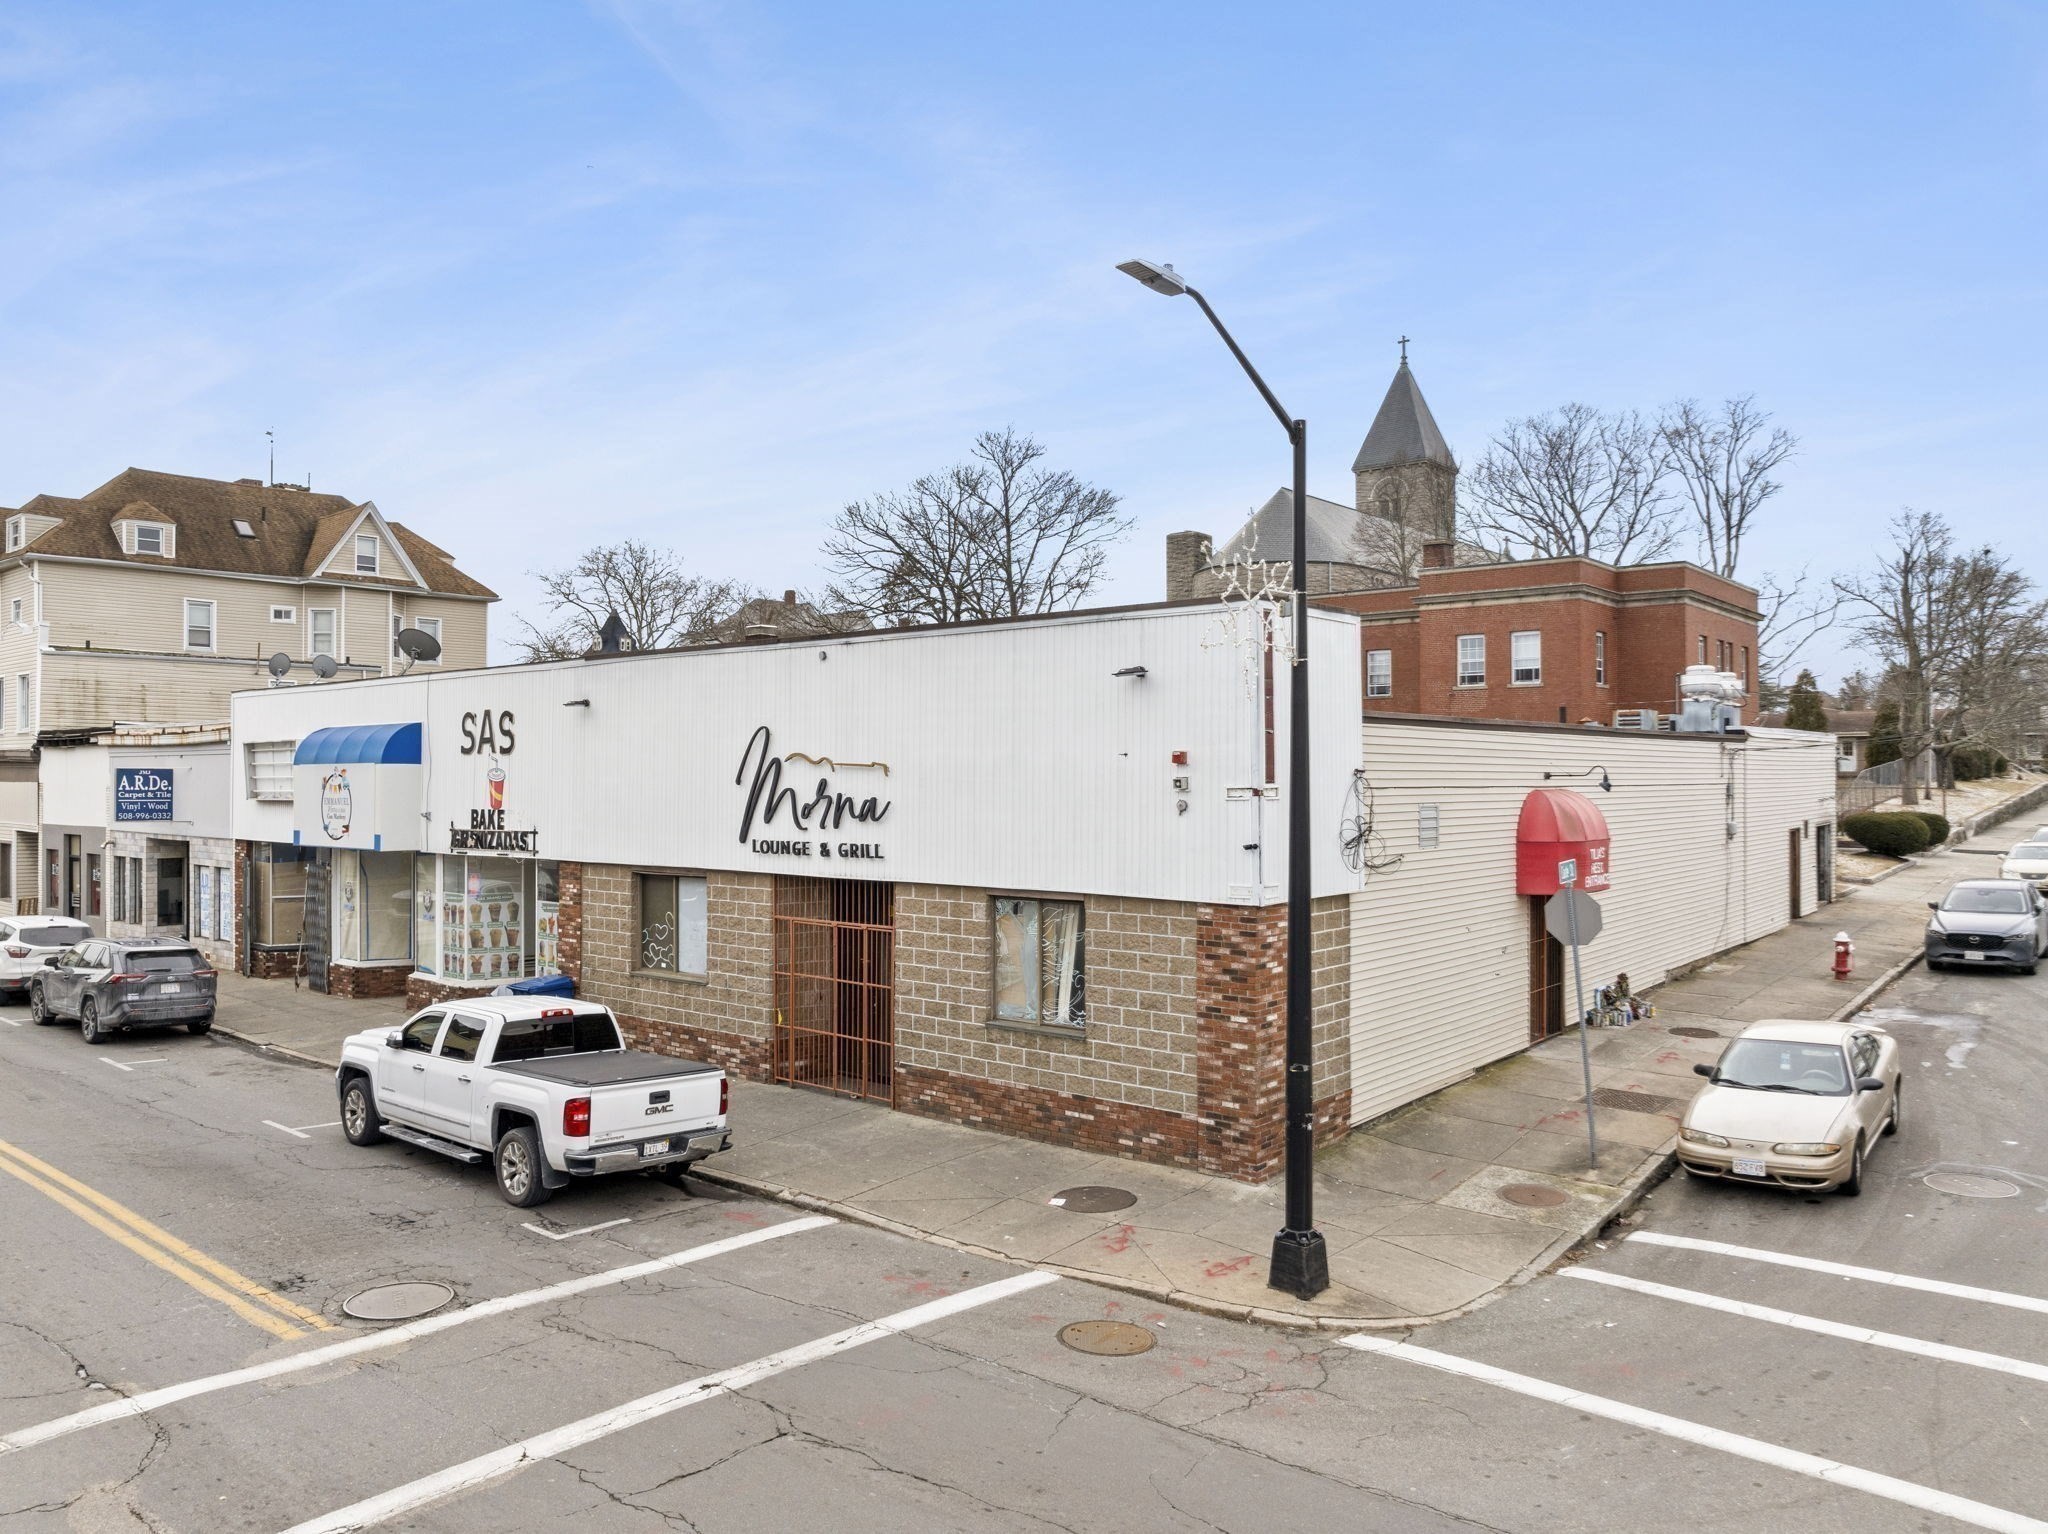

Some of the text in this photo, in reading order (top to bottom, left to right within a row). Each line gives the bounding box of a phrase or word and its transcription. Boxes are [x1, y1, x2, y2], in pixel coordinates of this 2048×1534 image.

[460, 709, 515, 755] SAS
[735, 725, 891, 844] Morna
[118, 791, 146, 799] Carpet
[121, 802, 169, 812] Vinyl Wood
[118, 812, 172, 820] 508-996-0332
[470, 808, 505, 830] BAKE
[751, 838, 885, 859] LOUNGE & GRILL
[645, 1104, 674, 1116] GMC
